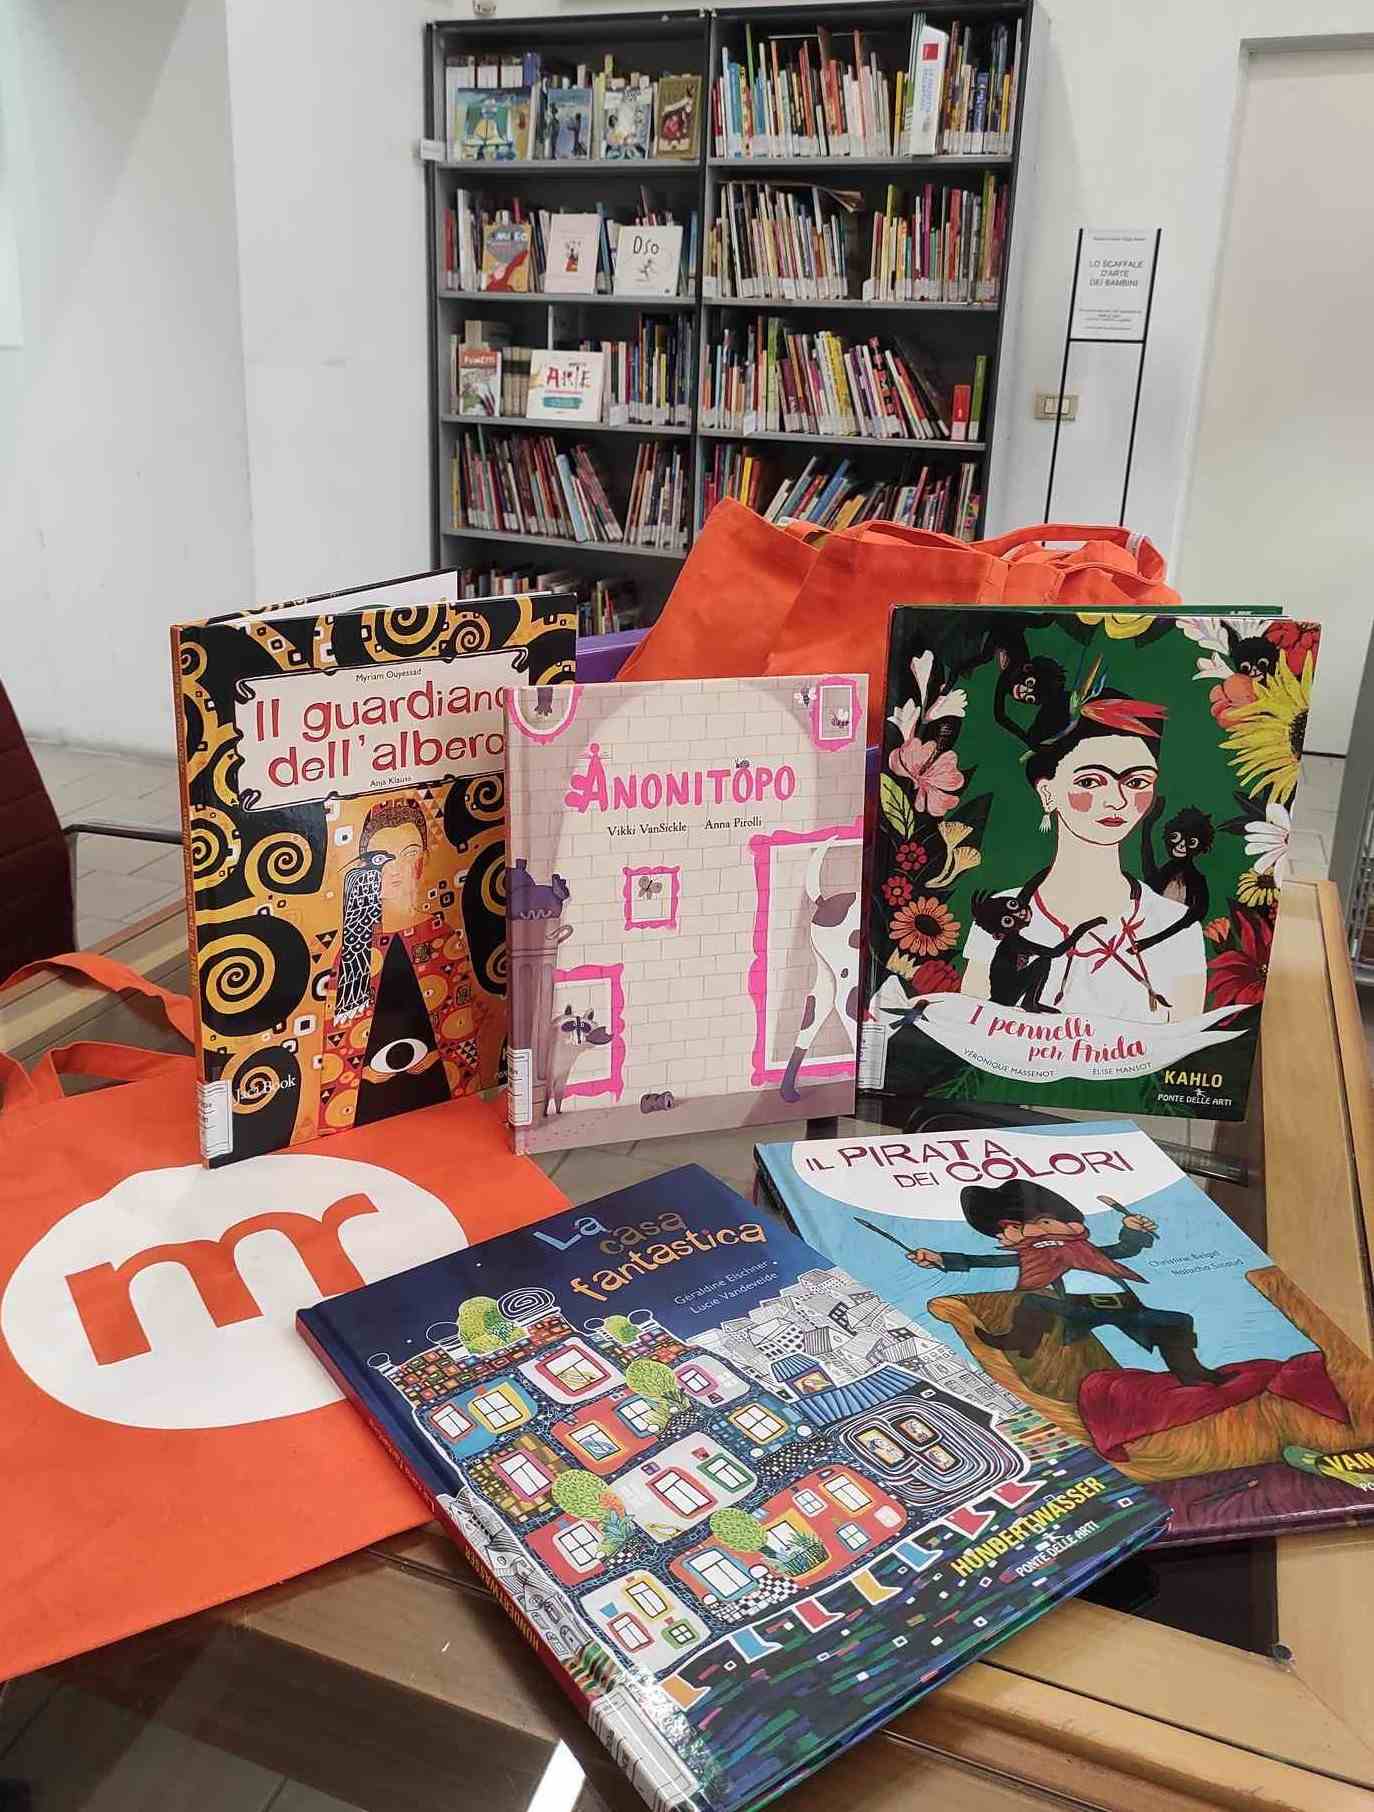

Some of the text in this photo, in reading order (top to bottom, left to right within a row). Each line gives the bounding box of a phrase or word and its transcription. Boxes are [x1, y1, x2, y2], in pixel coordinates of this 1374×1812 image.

[355, 673, 384, 683] Myriam
[256, 699, 279, 742] Il
[268, 730, 504, 788] dell'albero
[608, 815, 763, 837] Vikki VanSickle Anna Pirolli
[968, 1004, 1094, 1041] I pennelli
[1028, 1035, 1146, 1063] per Frida
[1010, 1067, 1054, 1078] MASSENOT
[1164, 1070, 1223, 1088] KAHLO
[1157, 1093, 1233, 1107] PONTE DELLE ARTI
[806, 1139, 1010, 1171] IL PIRATA
[893, 1150, 1135, 1188] DEI COLORI
[532, 1212, 689, 1255] La casa
[570, 1223, 768, 1302] fantastica
[951, 1476, 1106, 1578] HUNDERTWASSER
[1015, 1521, 1100, 1577] PONTE DELLE ARTI
